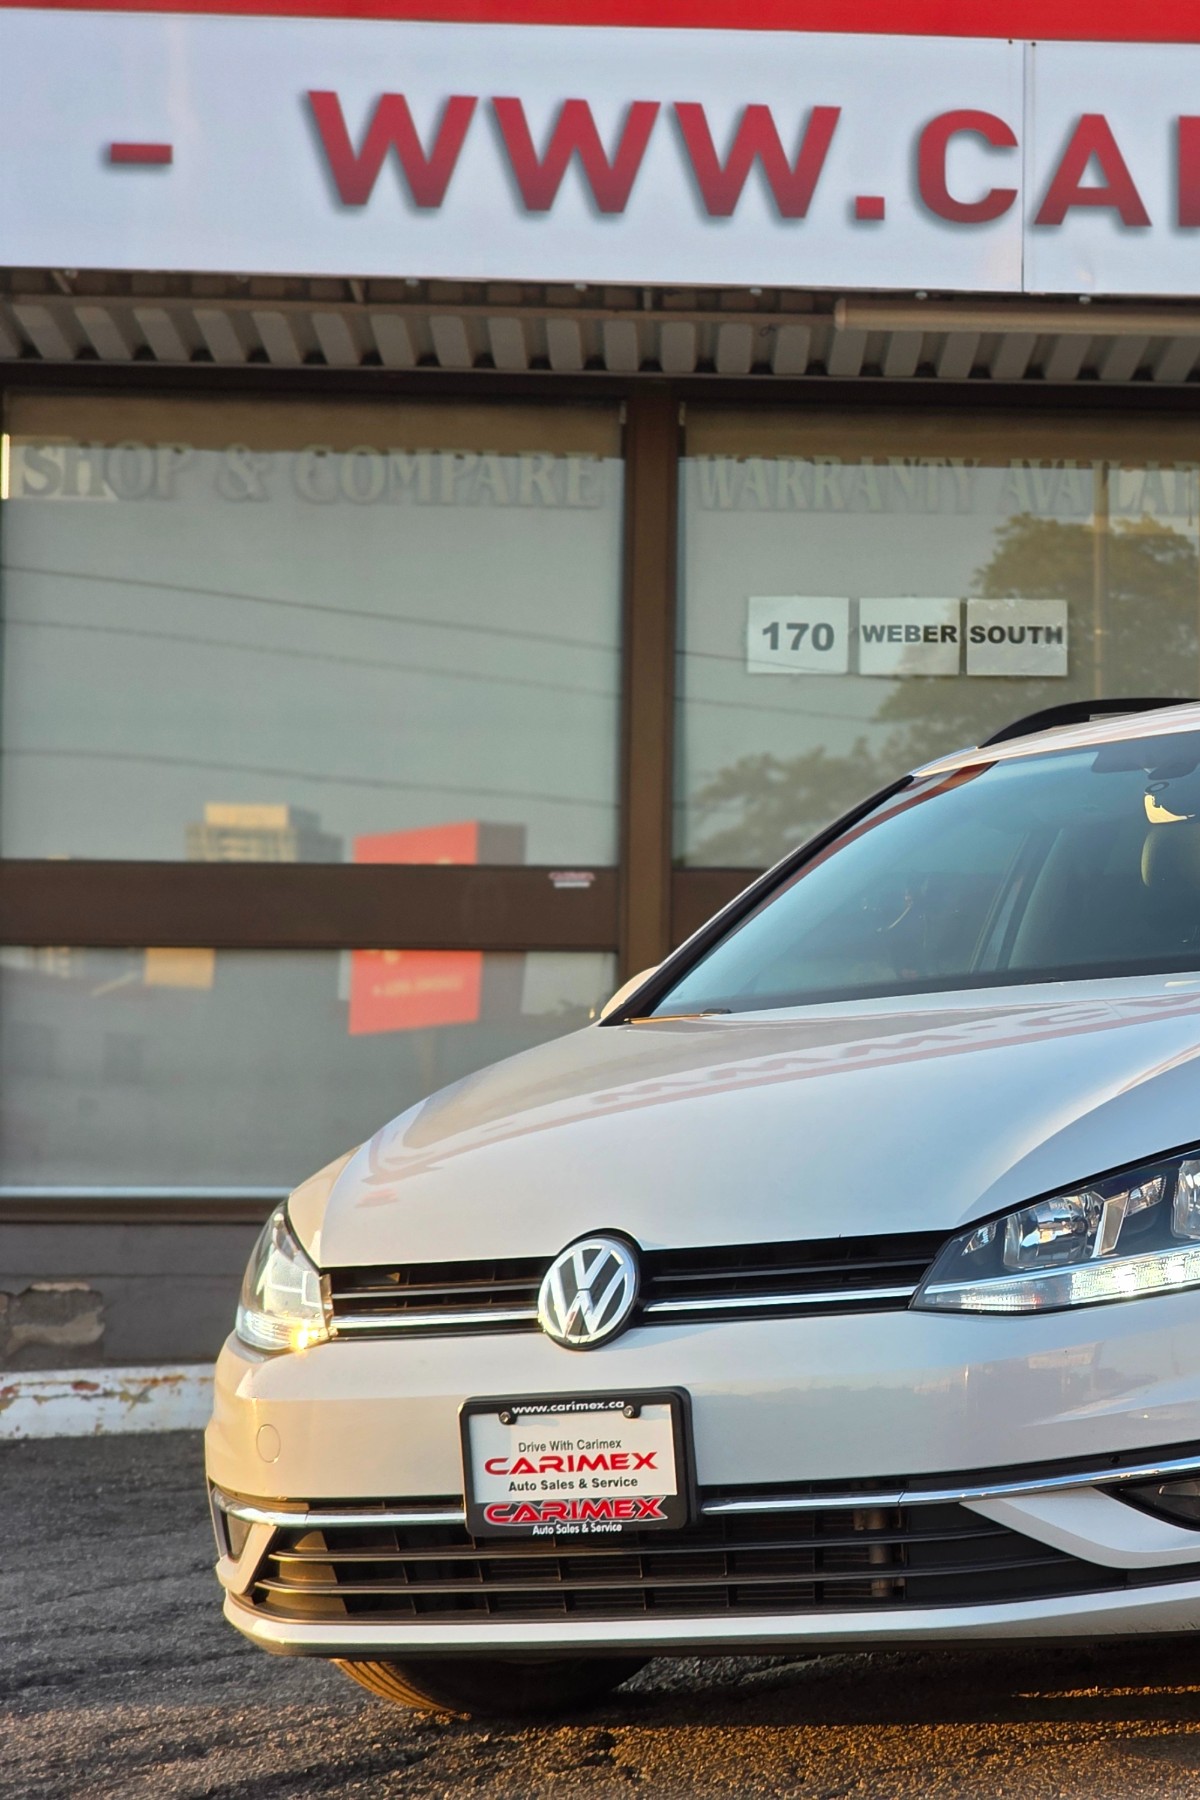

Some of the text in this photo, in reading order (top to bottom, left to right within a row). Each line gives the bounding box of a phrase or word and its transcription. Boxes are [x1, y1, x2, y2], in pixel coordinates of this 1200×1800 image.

[22, 440, 604, 508] SHOP & COMPARE
[694, 453, 982, 511] WARRANTY
[762, 622, 835, 651] 170
[861, 625, 958, 643] WEBER
[970, 626, 1063, 644] SOUTH
[511, 1400, 625, 1415] www.carimex.ca
[518, 1437, 622, 1453] Drive With Carimex
[484, 1451, 658, 1476] CARIMEX
[508, 1476, 639, 1493] Auto Sales & Service
[484, 1496, 667, 1526] CARIMEX
[532, 1520, 622, 1536] Auto Sales & Service
